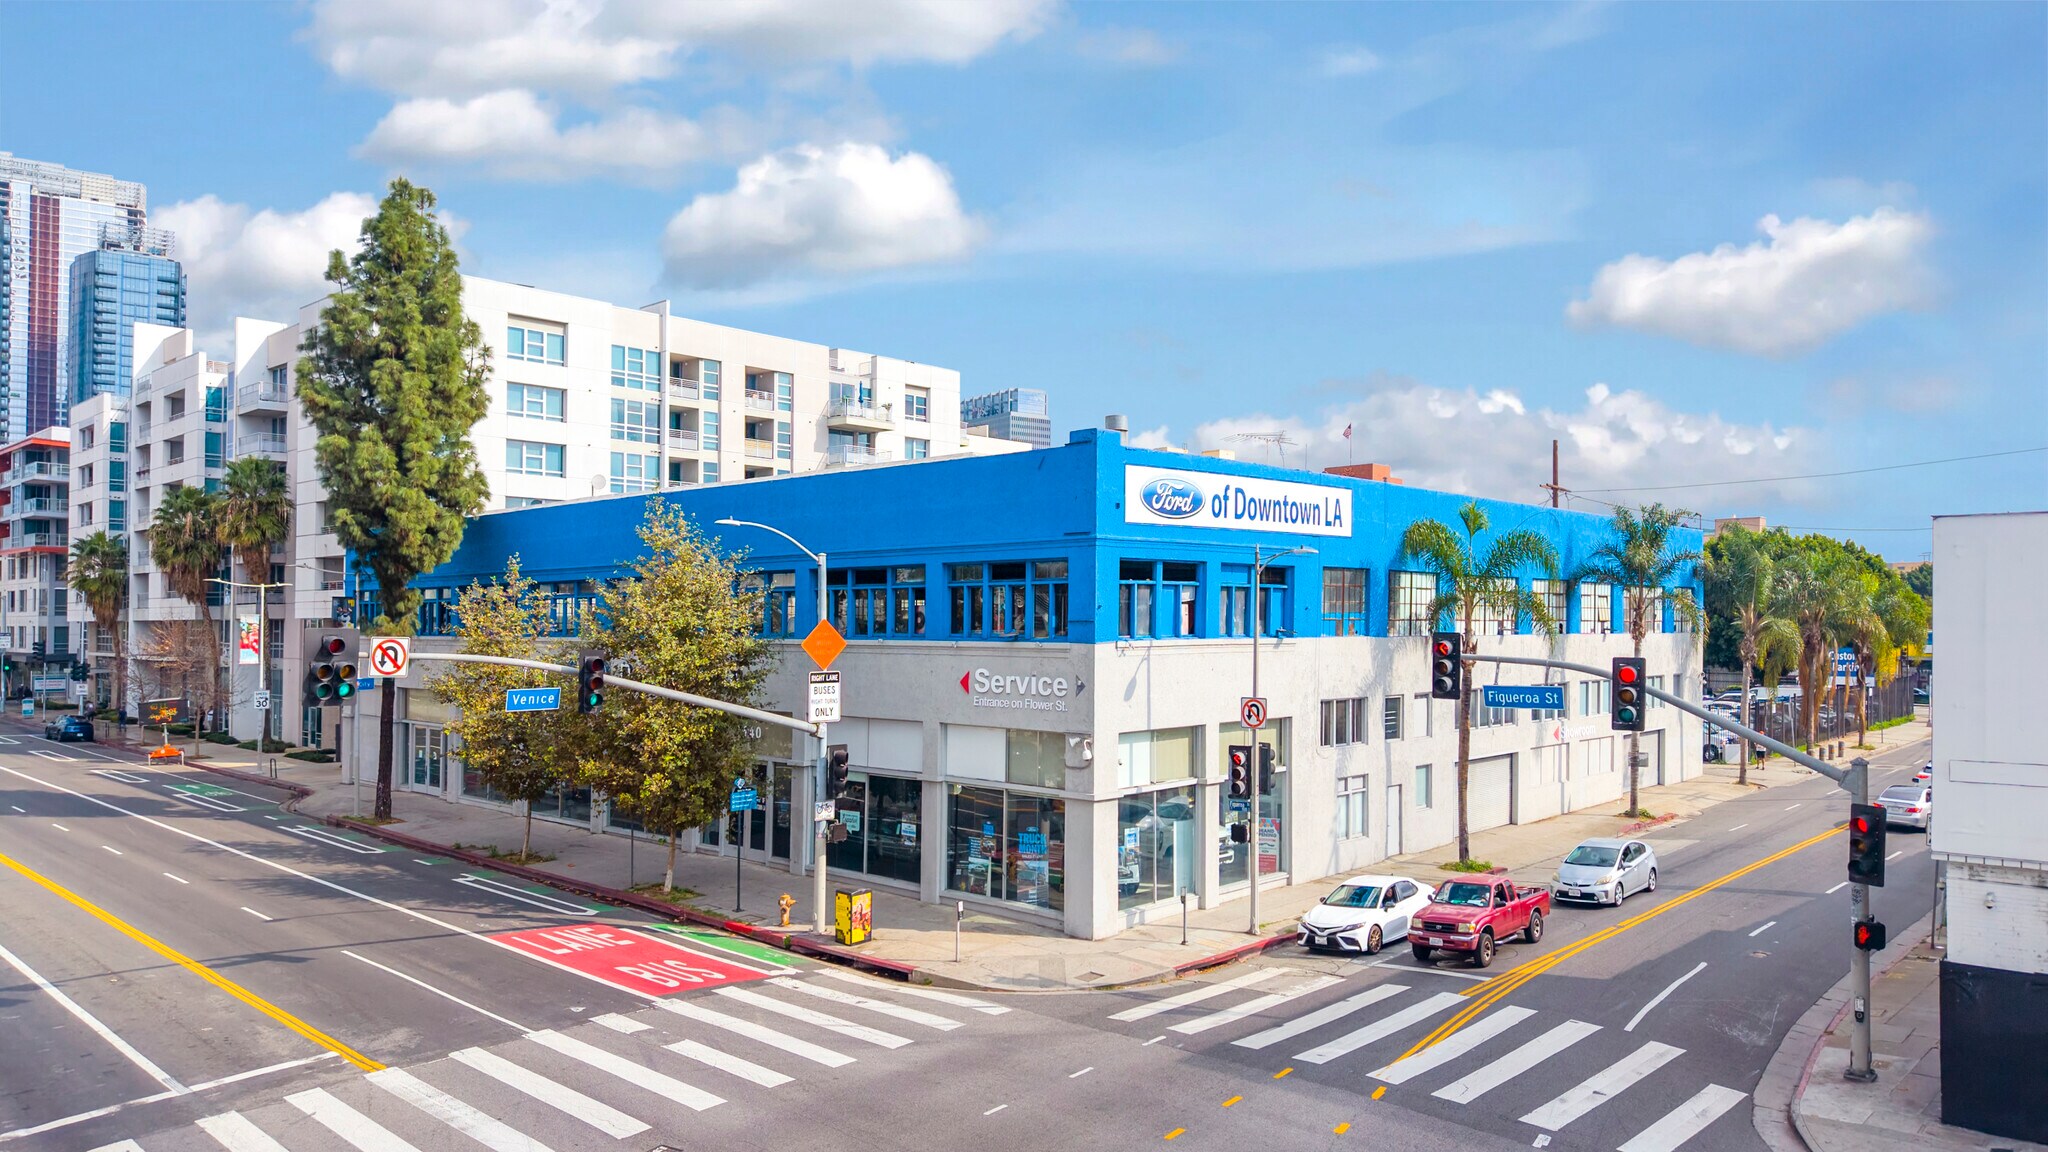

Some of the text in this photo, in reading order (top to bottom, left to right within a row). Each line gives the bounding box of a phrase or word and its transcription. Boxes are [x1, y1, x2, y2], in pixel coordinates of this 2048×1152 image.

[1152, 480, 1343, 527] Ford of Downtown LA
[811, 673, 839, 682] RIGHT LANE
[974, 668, 1068, 697] Service
[813, 686, 836, 695] BUSES
[256, 700, 268, 708] 30
[512, 694, 555, 706] Venice
[973, 696, 1068, 711] Entrance on Flower St.
[1488, 691, 1559, 706] Figueroa St
[815, 707, 834, 717] ONLY
[1560, 724, 1597, 739] Showroom
[1018, 832, 1047, 845] TRUCK
[1018, 844, 1047, 855] MONTH
[511, 927, 636, 955] LANE
[614, 959, 727, 988] BUS
